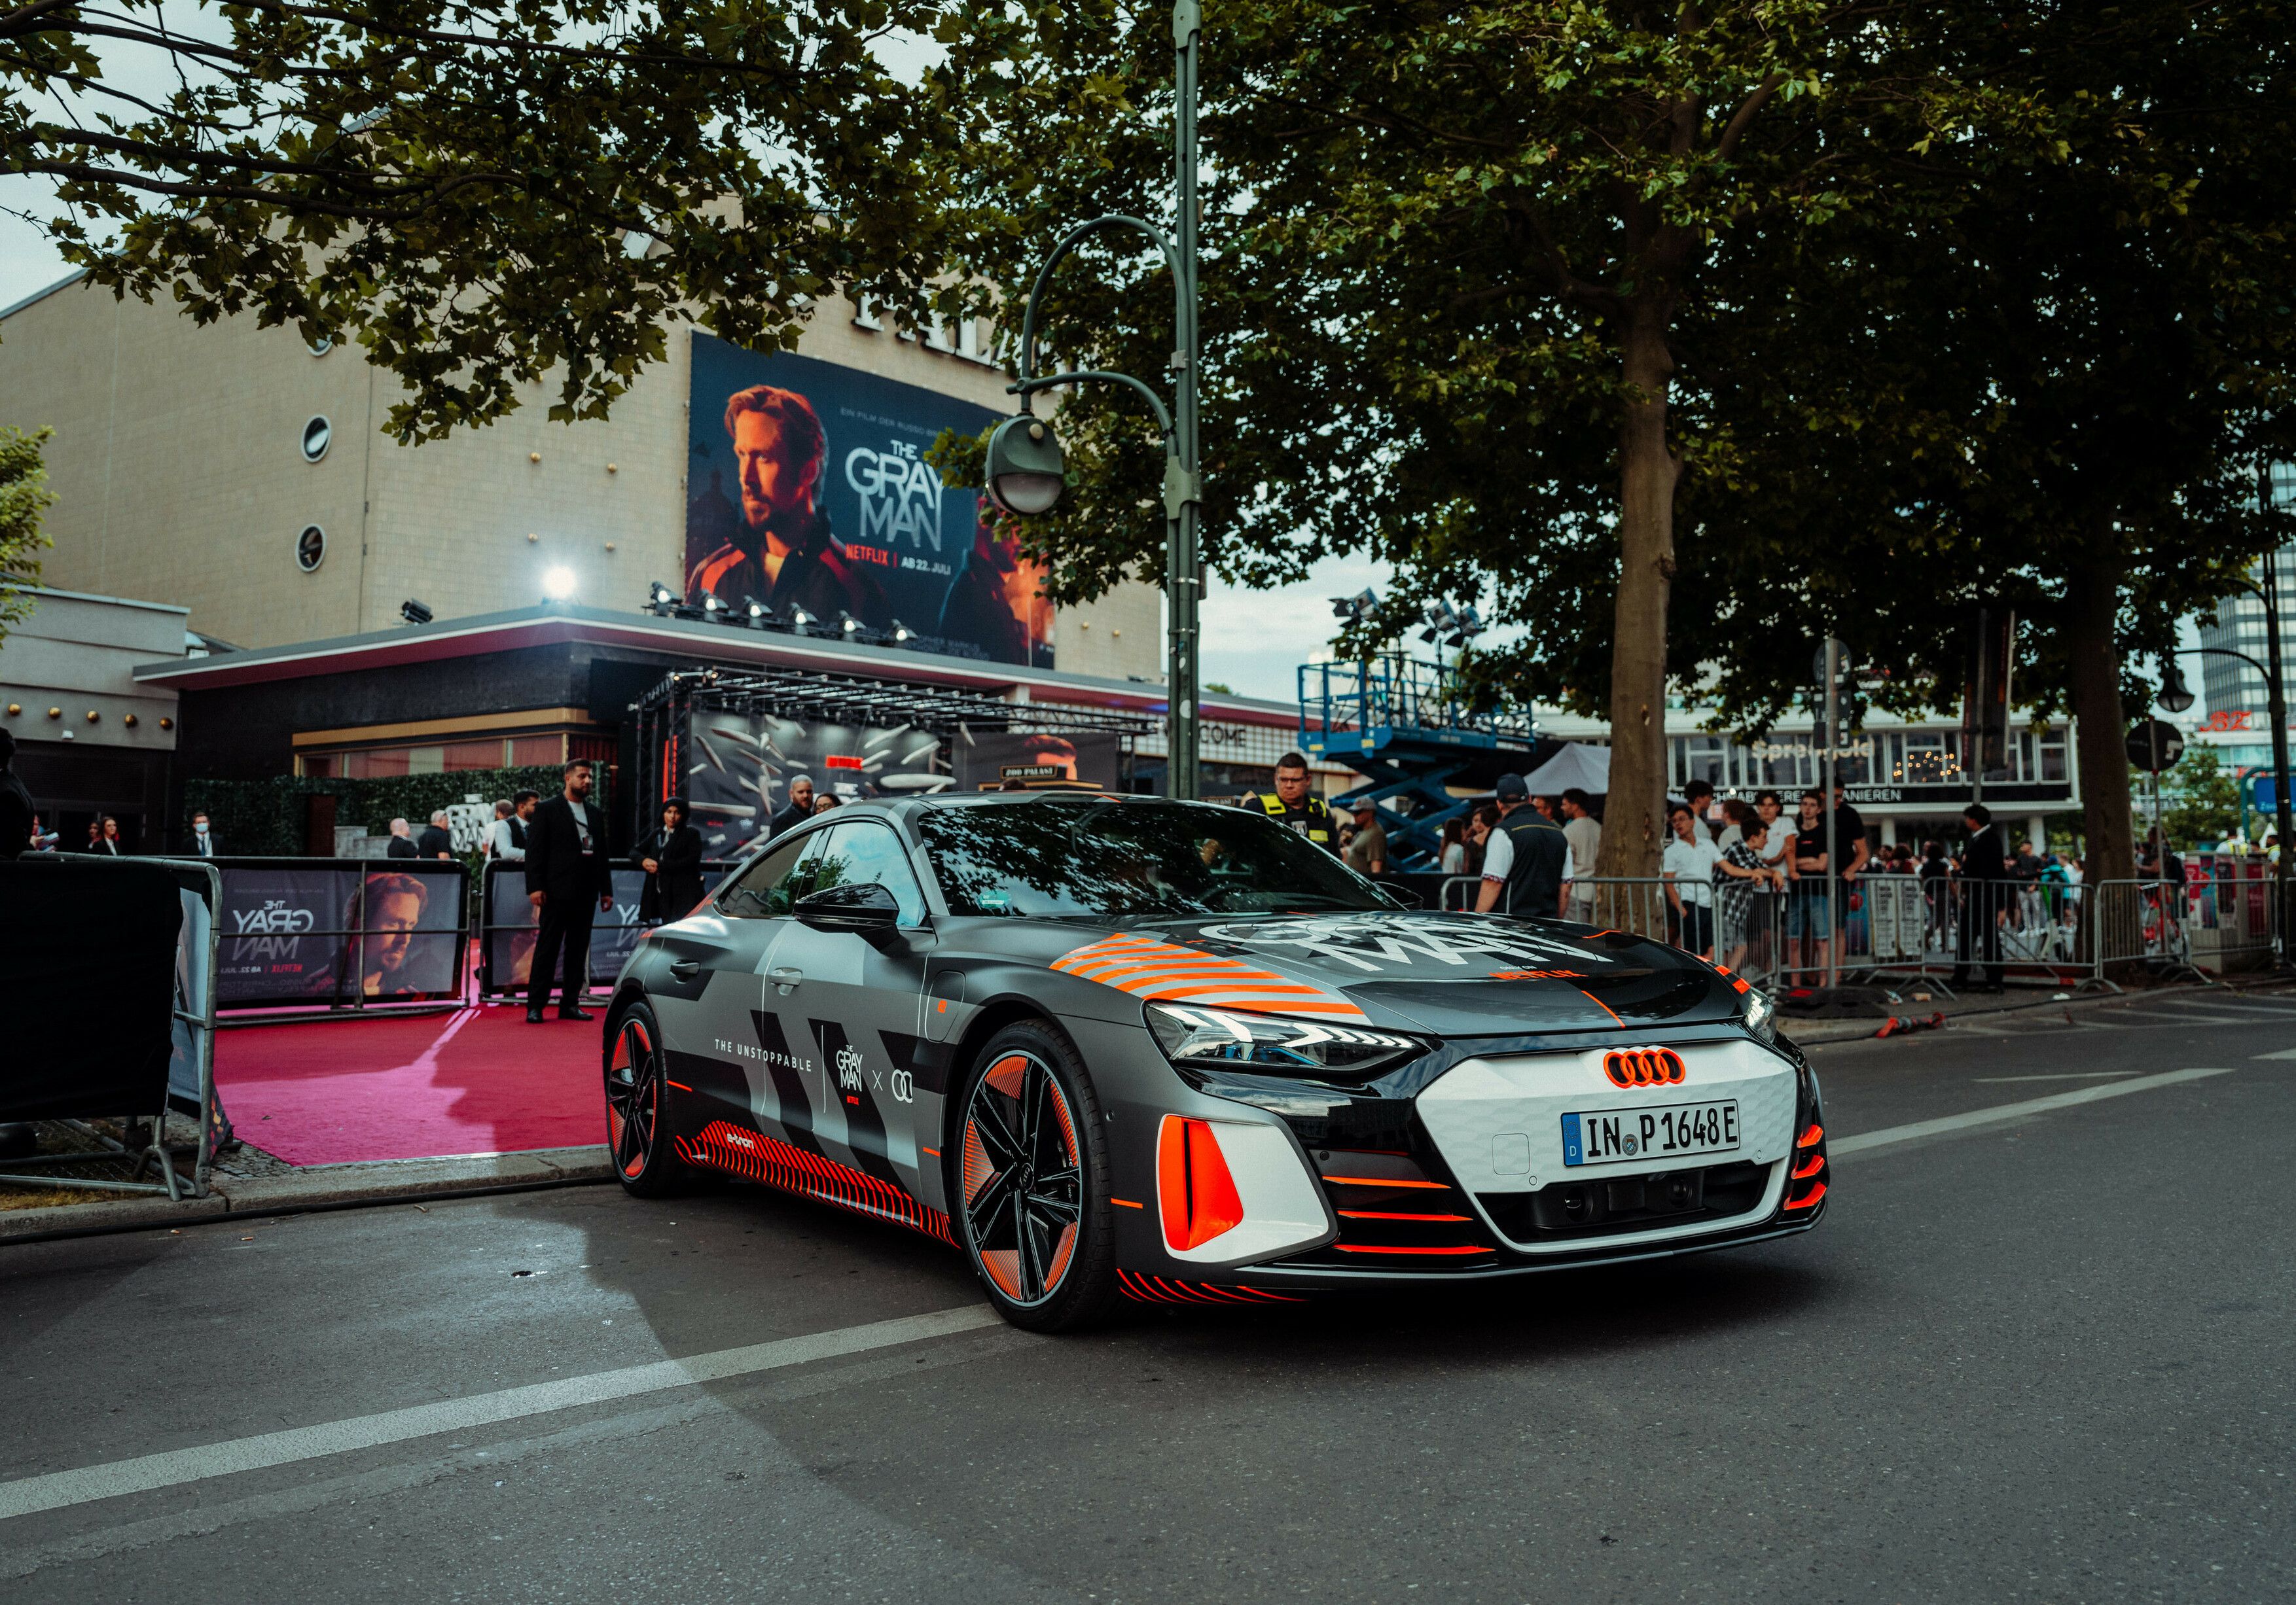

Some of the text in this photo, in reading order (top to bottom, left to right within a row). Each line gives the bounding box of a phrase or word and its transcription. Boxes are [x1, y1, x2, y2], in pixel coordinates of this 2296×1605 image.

[889, 439, 918, 460] THE
[845, 447, 944, 509] GRAY
[859, 493, 942, 552] MAN
[846, 544, 889, 566] NETFLIX
[901, 556, 916, 569] AB
[931, 562, 952, 576] JULI
[1293, 932, 1614, 972] MAN
[1488, 970, 1589, 980] NETFLIX
[715, 1038, 812, 1072] THE UNSTOPPABLE
[836, 1049, 863, 1073] GRAY
[840, 1069, 862, 1092] MAN
[726, 1133, 755, 1150] e-tron
[1587, 1116, 1621, 1157] IN
[1570, 1146, 1577, 1157] D
